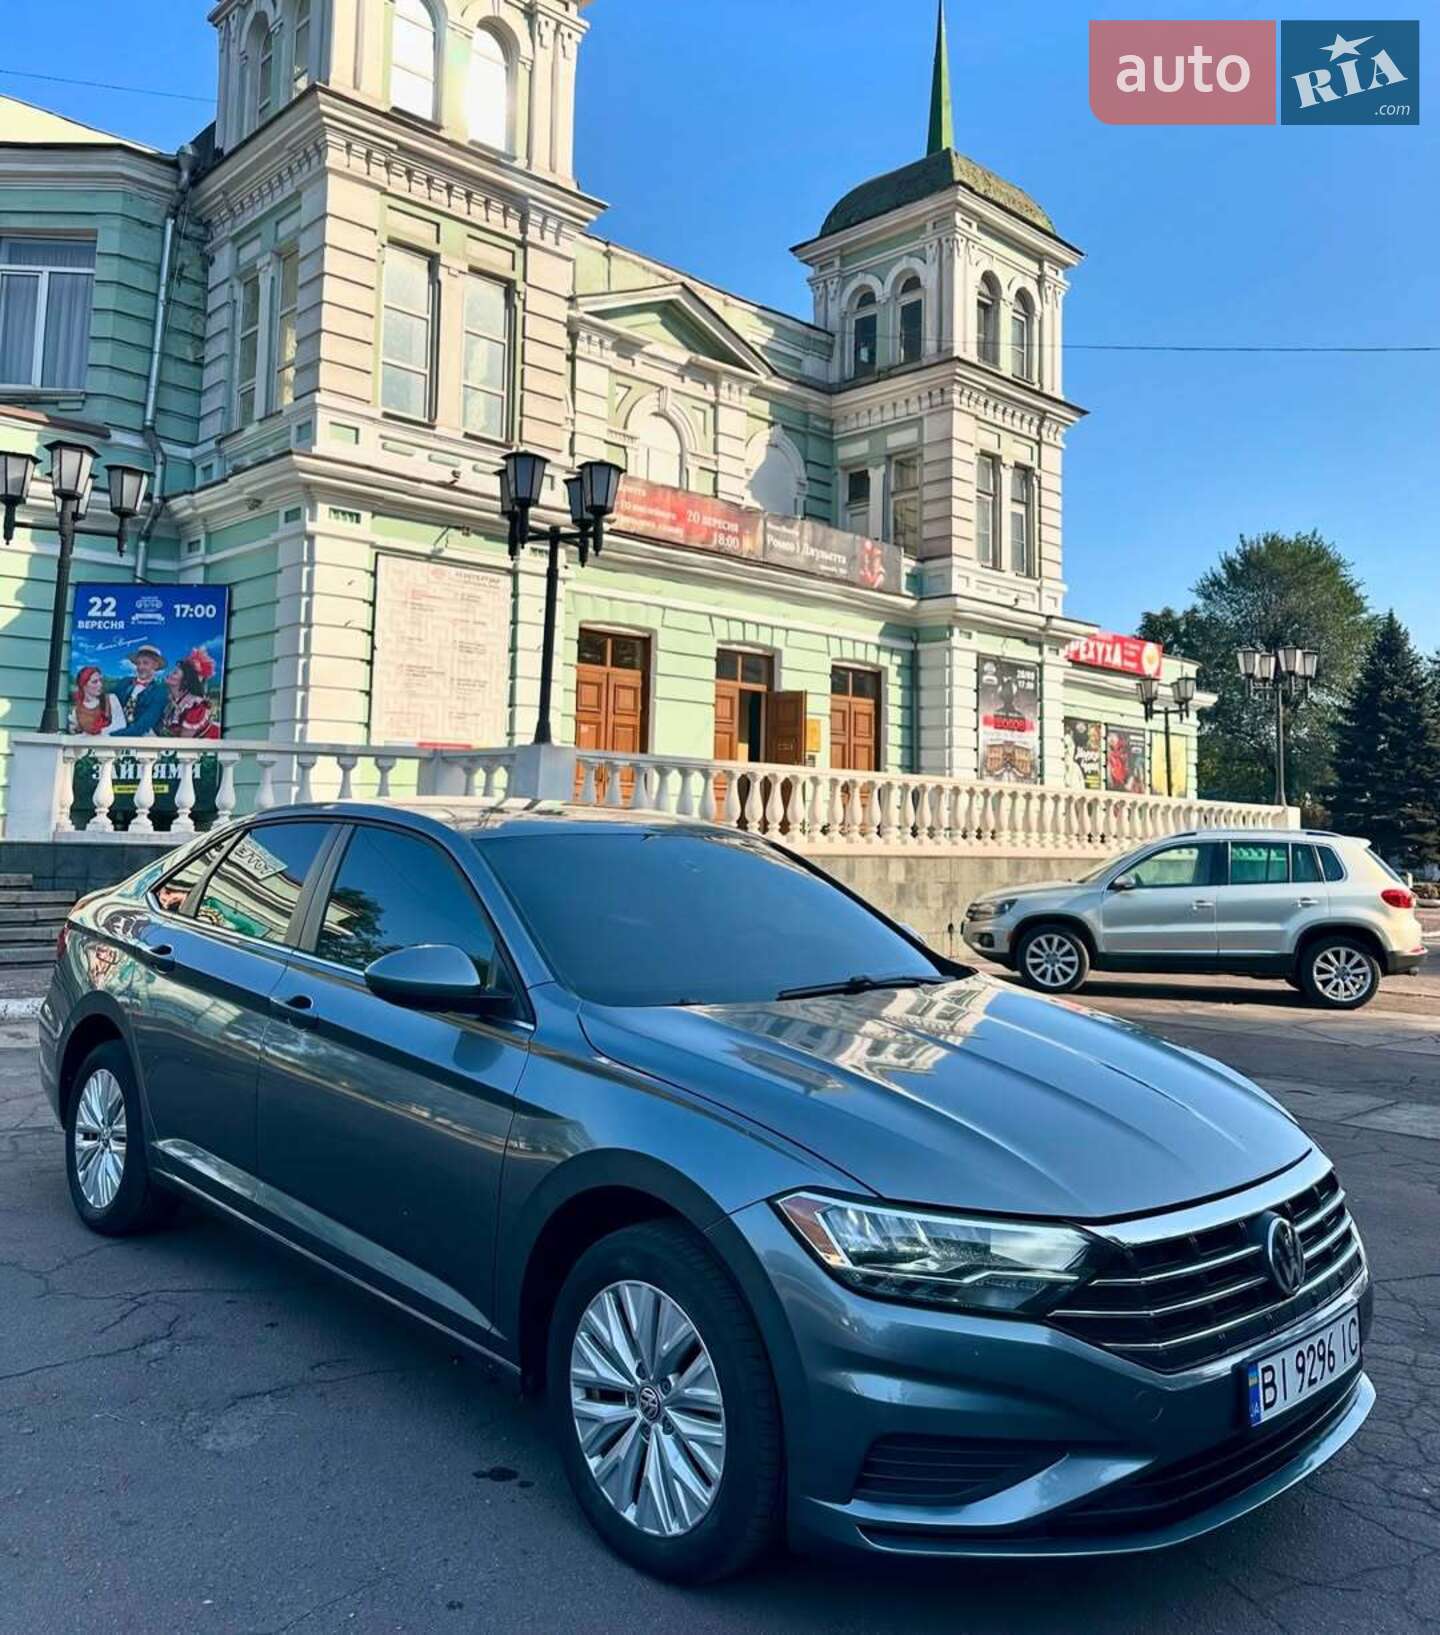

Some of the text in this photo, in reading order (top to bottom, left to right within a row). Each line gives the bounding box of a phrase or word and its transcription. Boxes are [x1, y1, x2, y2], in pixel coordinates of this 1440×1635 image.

[686, 510, 701, 524] 20
[713, 531, 740, 549] 18:00
[87, 596, 117, 617] 22
[172, 604, 217, 619] 17:00
[77, 620, 125, 630] ВЕРЕСНЯ
[1261, 1318, 1359, 1412] BI 9296 IC
